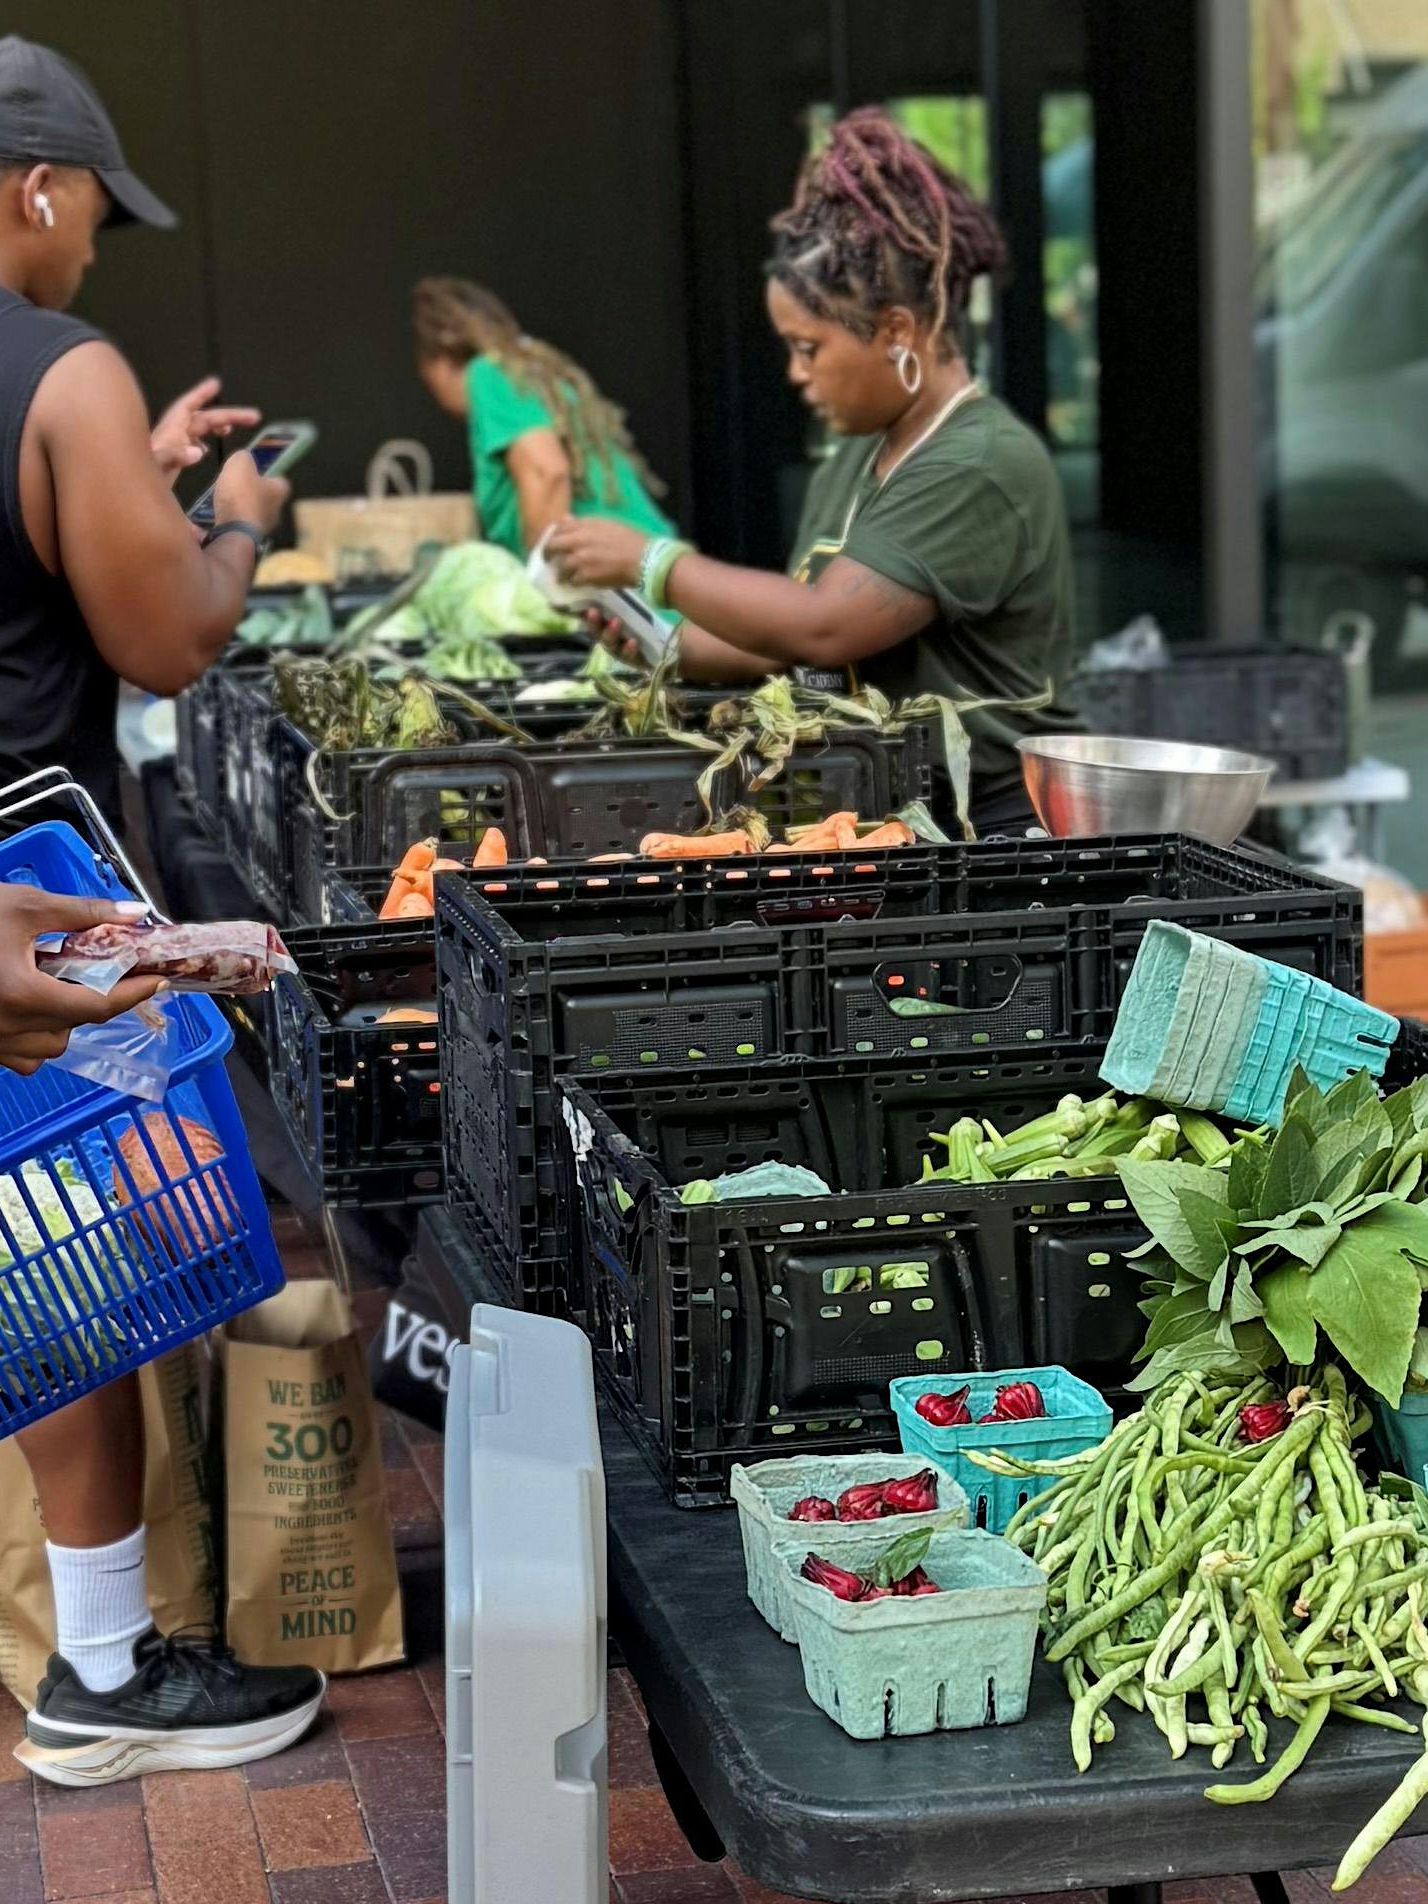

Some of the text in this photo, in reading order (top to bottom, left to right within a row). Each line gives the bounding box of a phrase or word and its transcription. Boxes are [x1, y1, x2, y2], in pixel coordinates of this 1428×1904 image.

[268, 1379, 304, 1407] WE
[266, 1416, 352, 1462] 300
[280, 1565, 355, 1594] PEACE
[280, 1608, 356, 1641] MIND
